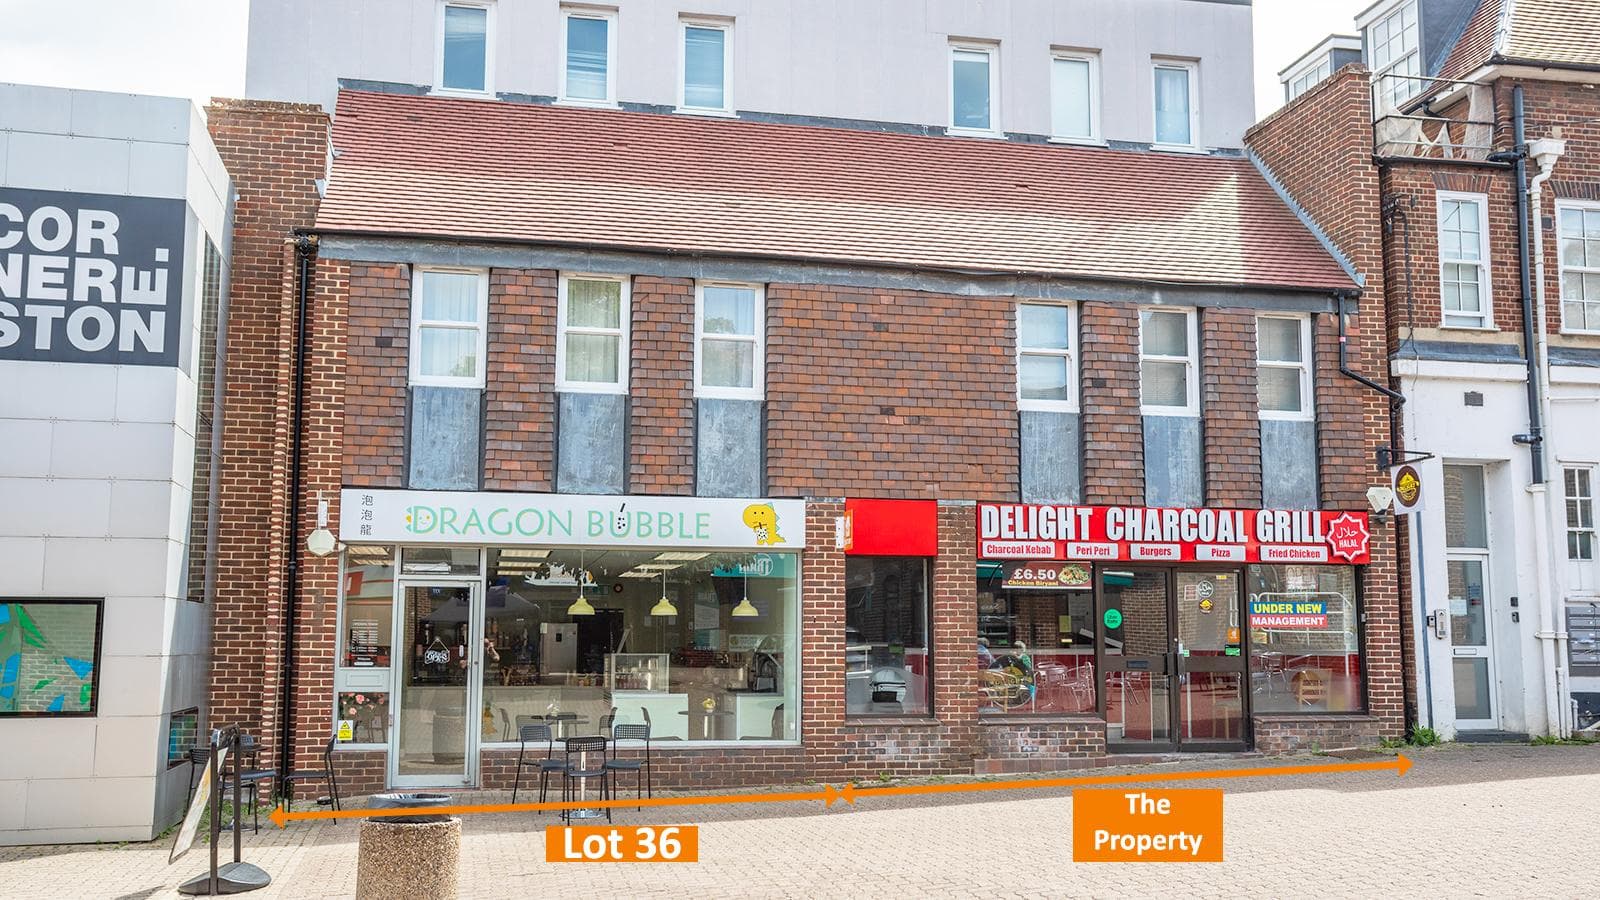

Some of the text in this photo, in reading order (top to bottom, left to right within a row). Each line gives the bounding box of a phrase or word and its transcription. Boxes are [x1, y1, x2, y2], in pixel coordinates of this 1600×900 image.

[411, 502, 711, 539] DRAGON BUBBLE
[981, 505, 1327, 544] DELIGHT CHARCOAL GRILL
[986, 544, 1052, 556] Charcoal Kebab
[1338, 540, 1359, 549] HALAL
[1075, 546, 1110, 556] Peri Peri
[1139, 546, 1172, 558] Burgers
[1211, 548, 1231, 558] Pizza
[1268, 549, 1321, 560] Fried Chicken
[1014, 568, 1056, 580] £6.50
[1253, 603, 1322, 614] UNDER NEW
[1251, 616, 1325, 626] MANAGEMENT
